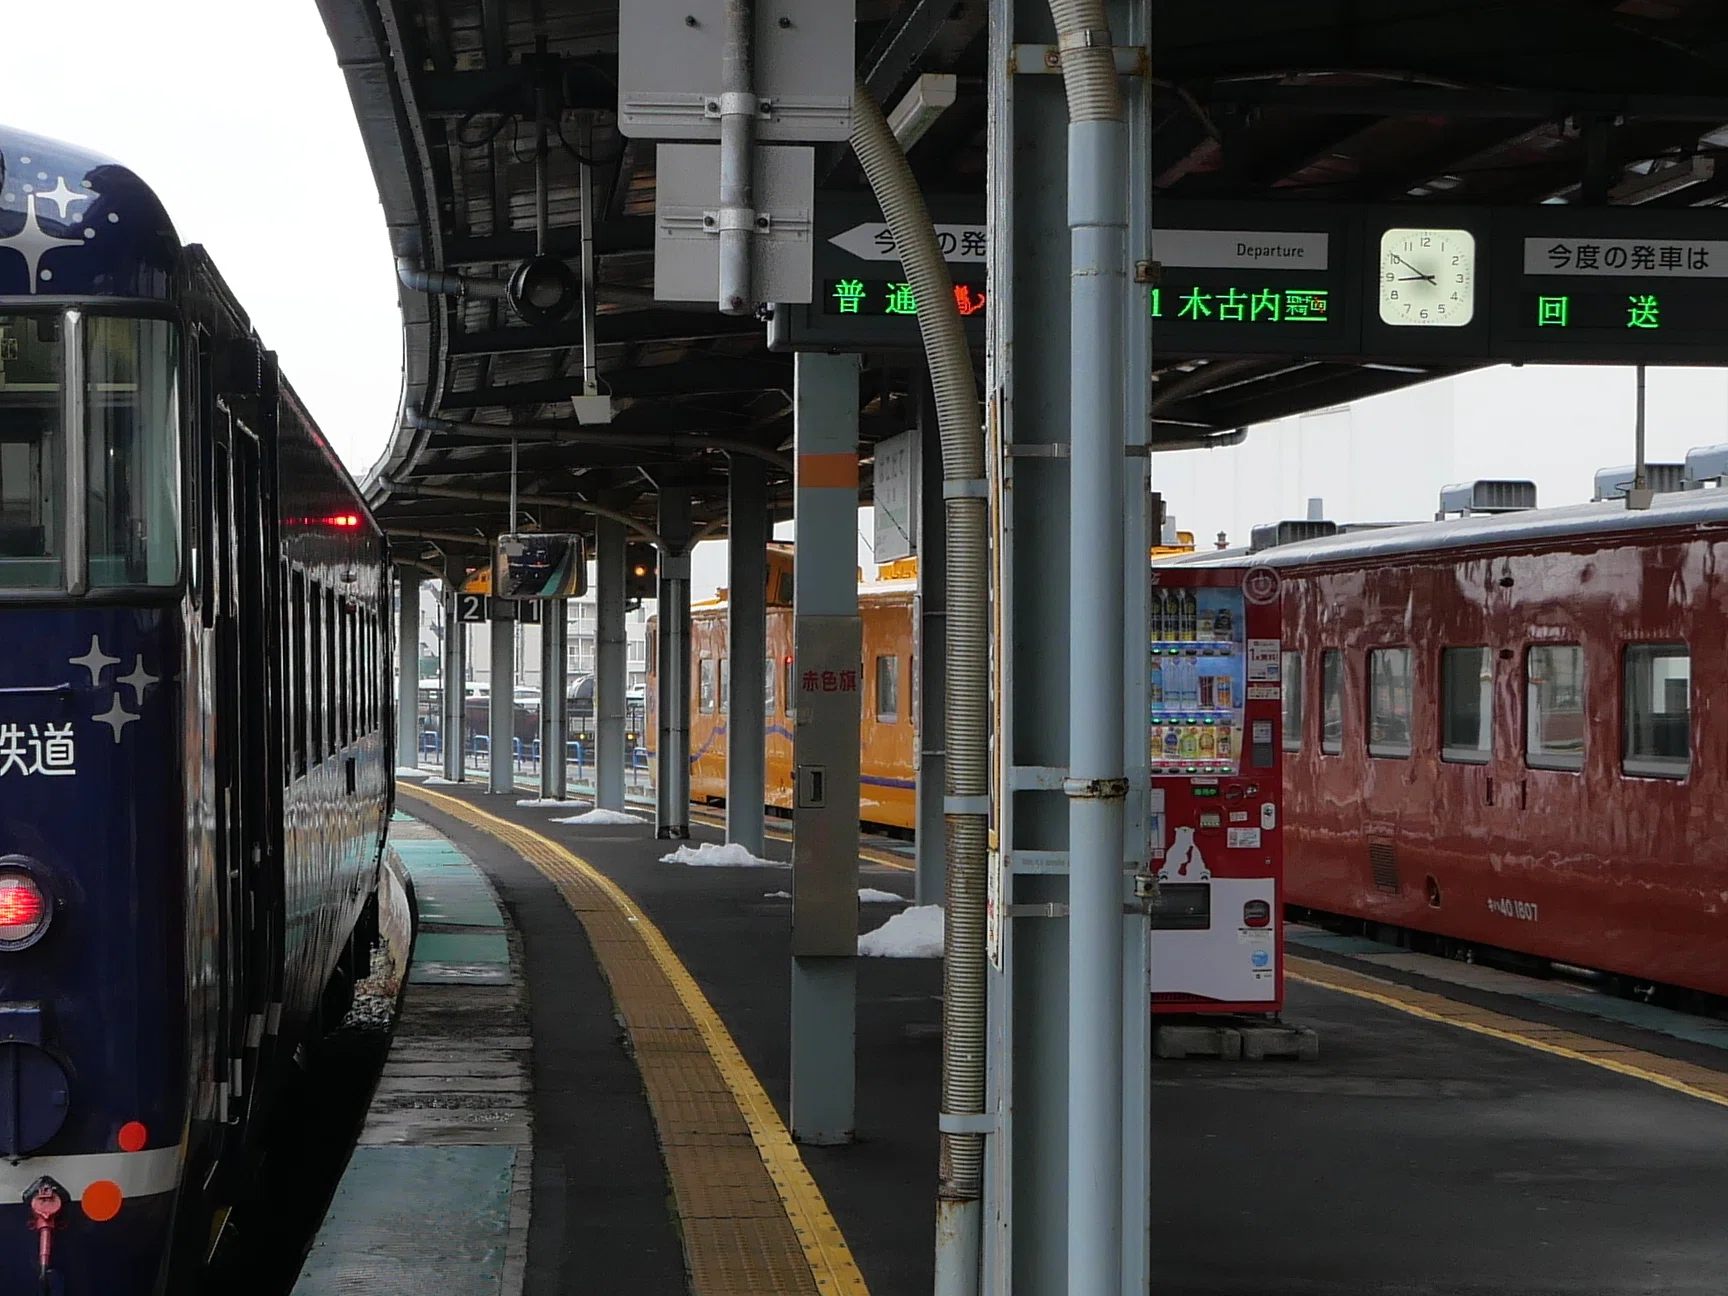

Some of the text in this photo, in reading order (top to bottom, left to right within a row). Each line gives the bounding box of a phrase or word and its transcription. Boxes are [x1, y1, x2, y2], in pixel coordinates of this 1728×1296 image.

[1237, 242, 1304, 259] Departure
[1547, 244, 1709, 271] 今度の発車は
[1177, 287, 1280, 321] 木古内
[463, 596, 479, 619] 2
[528, 599, 538, 621] 1
[802, 670, 857, 692] 赤色旗
